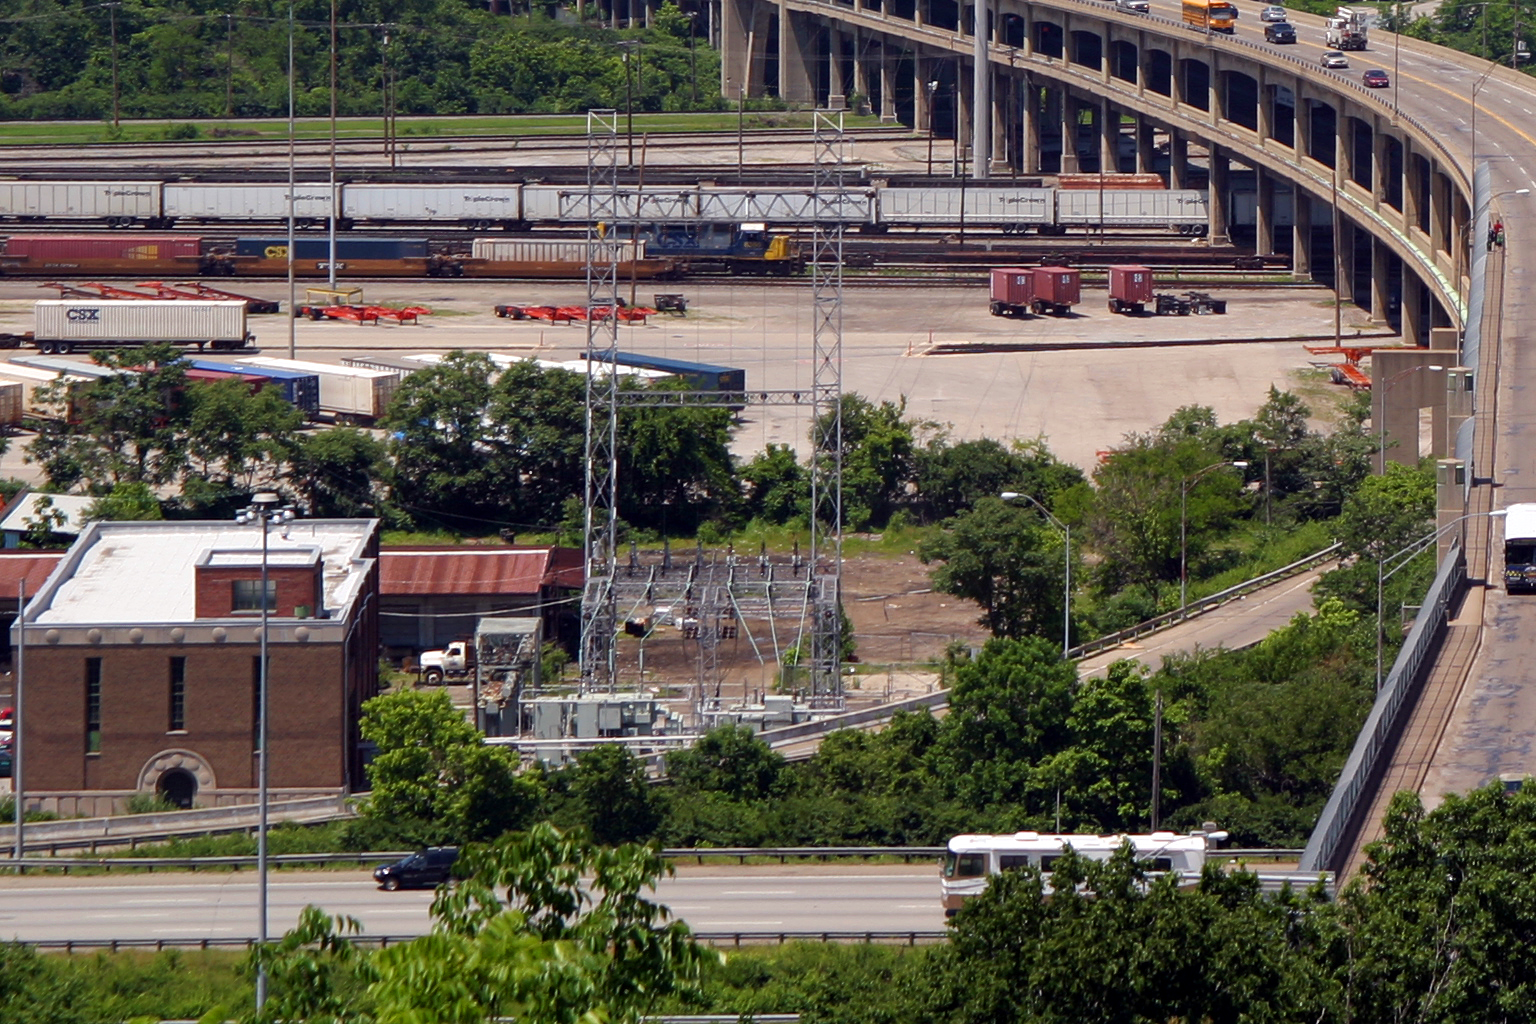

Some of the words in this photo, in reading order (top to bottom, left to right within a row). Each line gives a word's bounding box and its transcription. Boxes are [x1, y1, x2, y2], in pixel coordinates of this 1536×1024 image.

[104, 189, 151, 197] TrpleCrown
[284, 194, 331, 203] TrpleCrown
[463, 195, 510, 203] TrpleCrown
[998, 197, 1045, 205] TrpleCrown
[317, 261, 345, 270] TX
[66, 309, 99, 323] CSX
